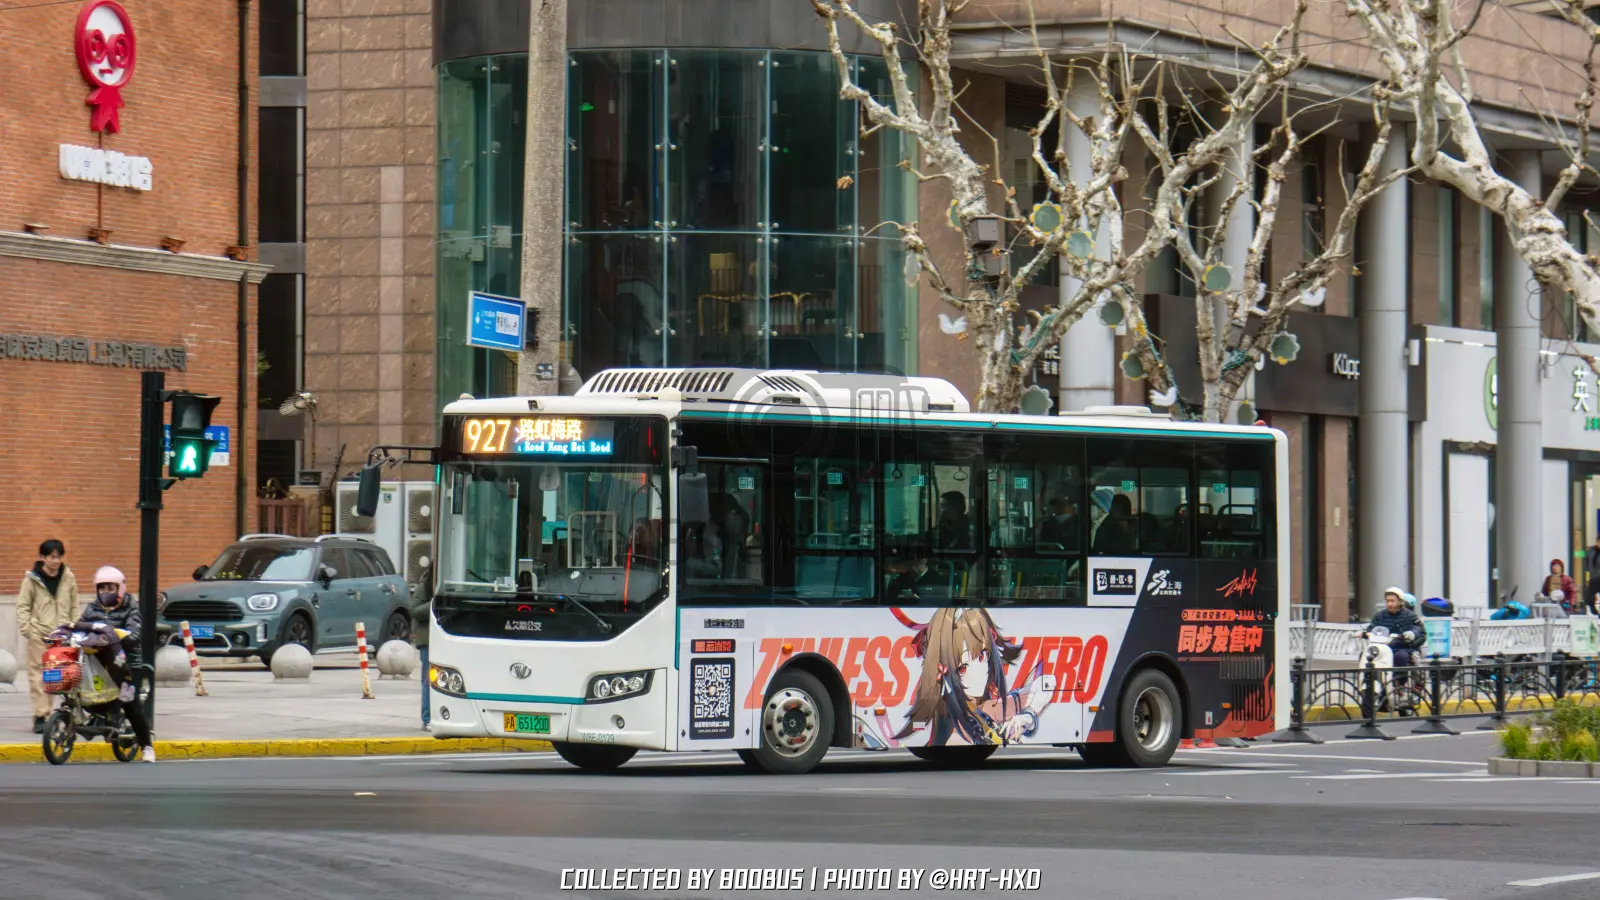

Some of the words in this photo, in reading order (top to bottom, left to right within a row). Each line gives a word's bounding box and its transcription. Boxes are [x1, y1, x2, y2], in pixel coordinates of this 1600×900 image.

[1572, 366, 1600, 413] 英
[467, 419, 511, 452] 927
[515, 418, 583, 443] 路虹梅路
[525, 441, 545, 452] Road
[590, 441, 611, 453] Road
[1166, 581, 1182, 590] 上海
[1177, 624, 1263, 653] 同步发售中
[1008, 634, 1109, 705] ZERO
